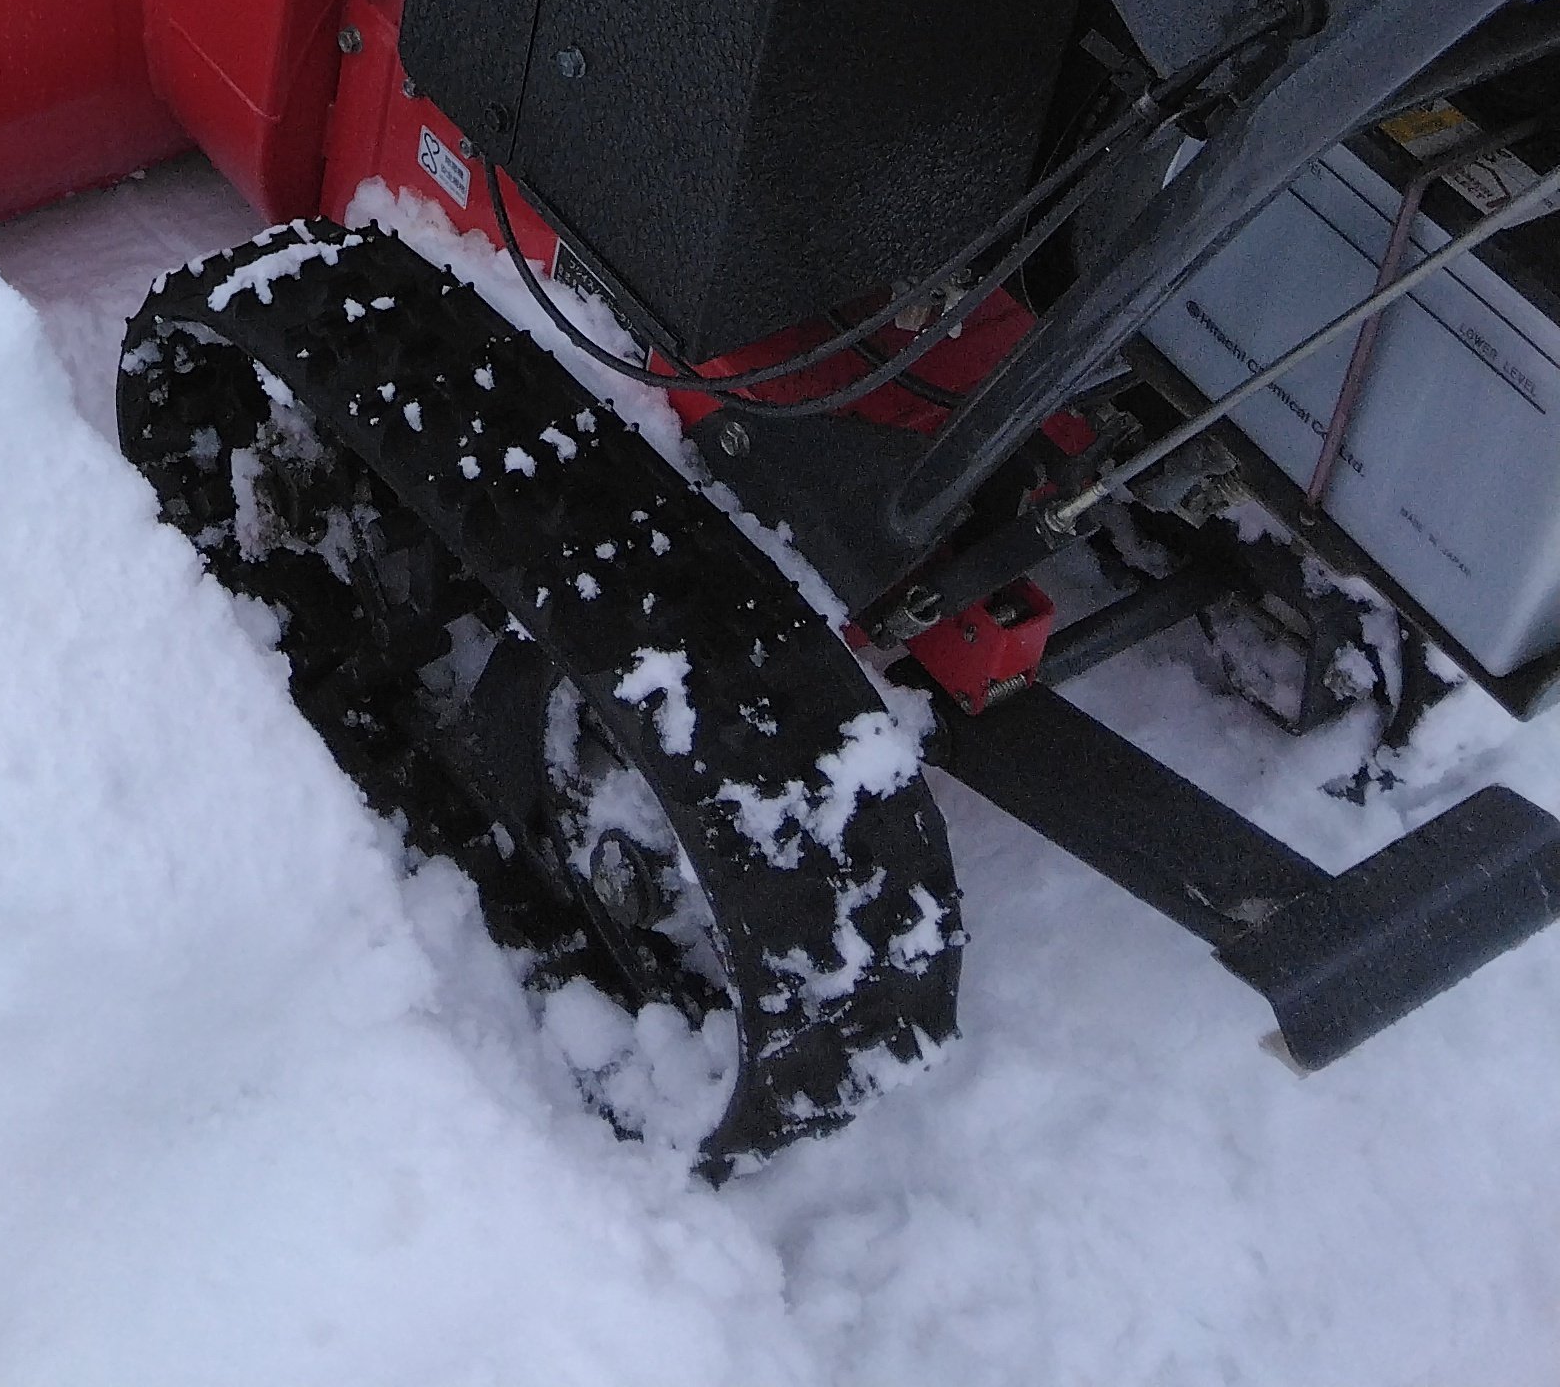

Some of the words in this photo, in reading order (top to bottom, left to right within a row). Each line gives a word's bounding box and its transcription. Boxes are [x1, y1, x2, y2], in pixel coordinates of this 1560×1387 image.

[1200, 312, 1247, 362] Hitachi
[1247, 359, 1310, 423] Cmical
[1459, 323, 1498, 359] LOWER
[1503, 361, 1537, 396] LEVEL
